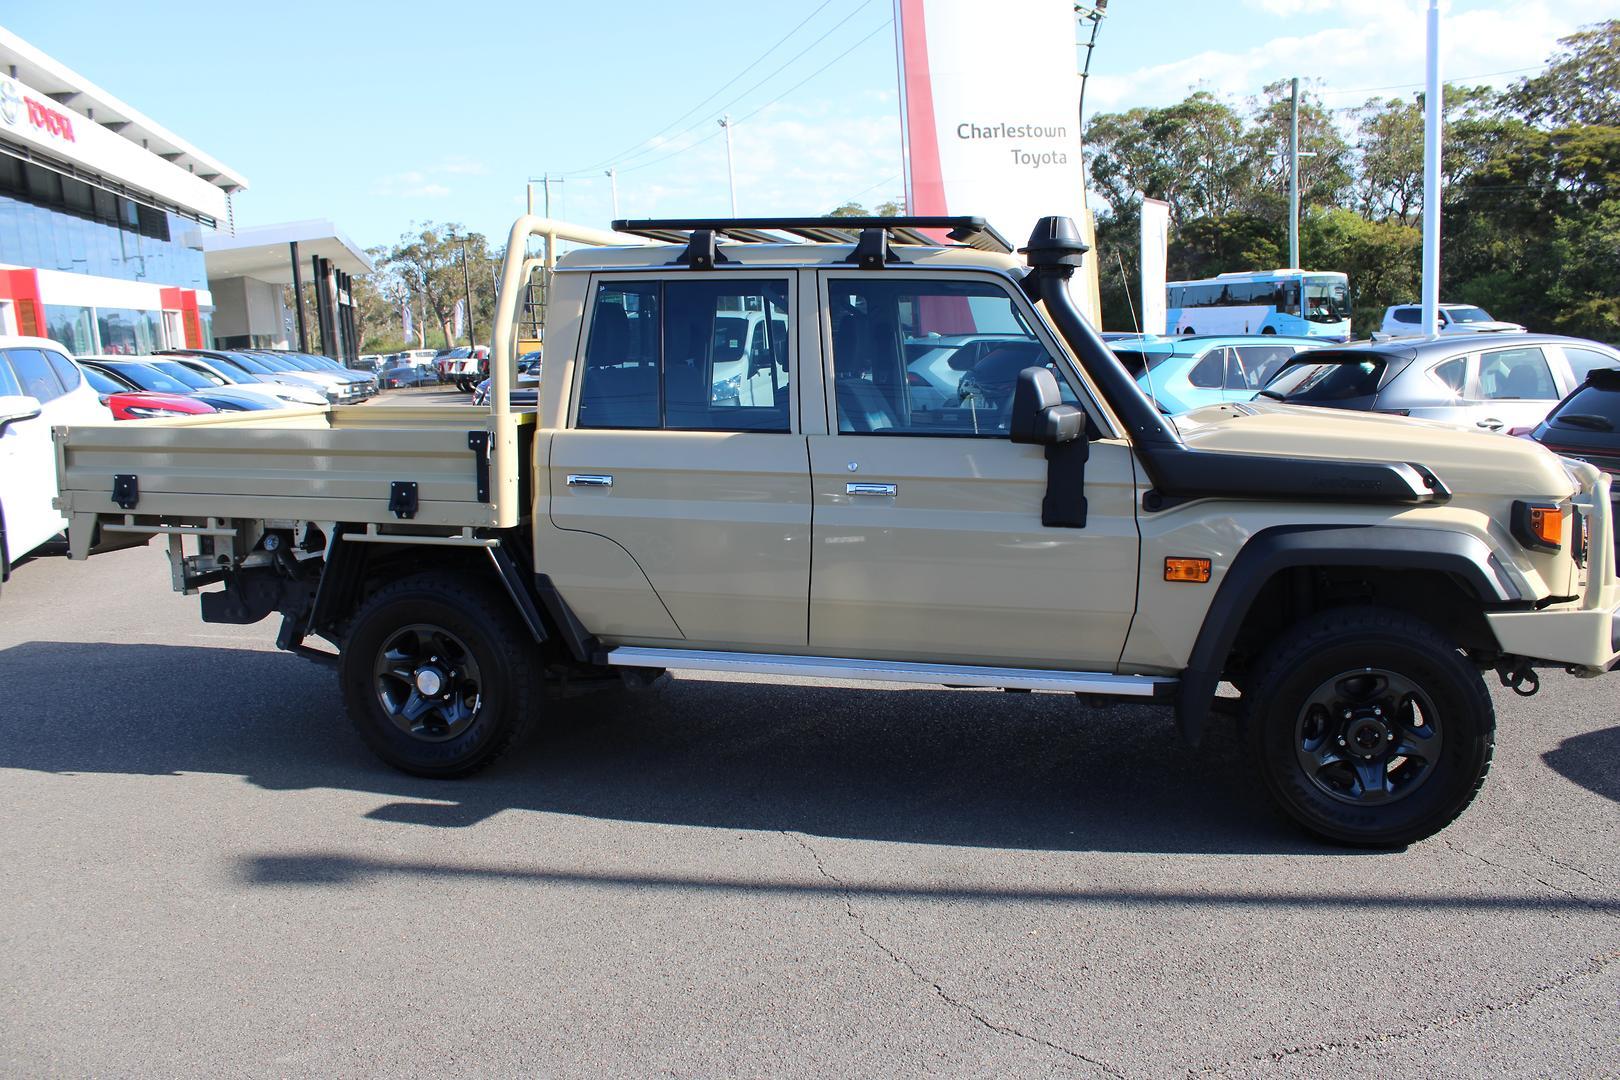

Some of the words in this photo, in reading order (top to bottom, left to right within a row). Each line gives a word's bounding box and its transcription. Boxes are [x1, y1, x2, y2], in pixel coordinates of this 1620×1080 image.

[23, 95, 76, 143] TOYOTA
[957, 123, 1067, 140] Charlestown
[1011, 149, 1067, 168] Toyota
